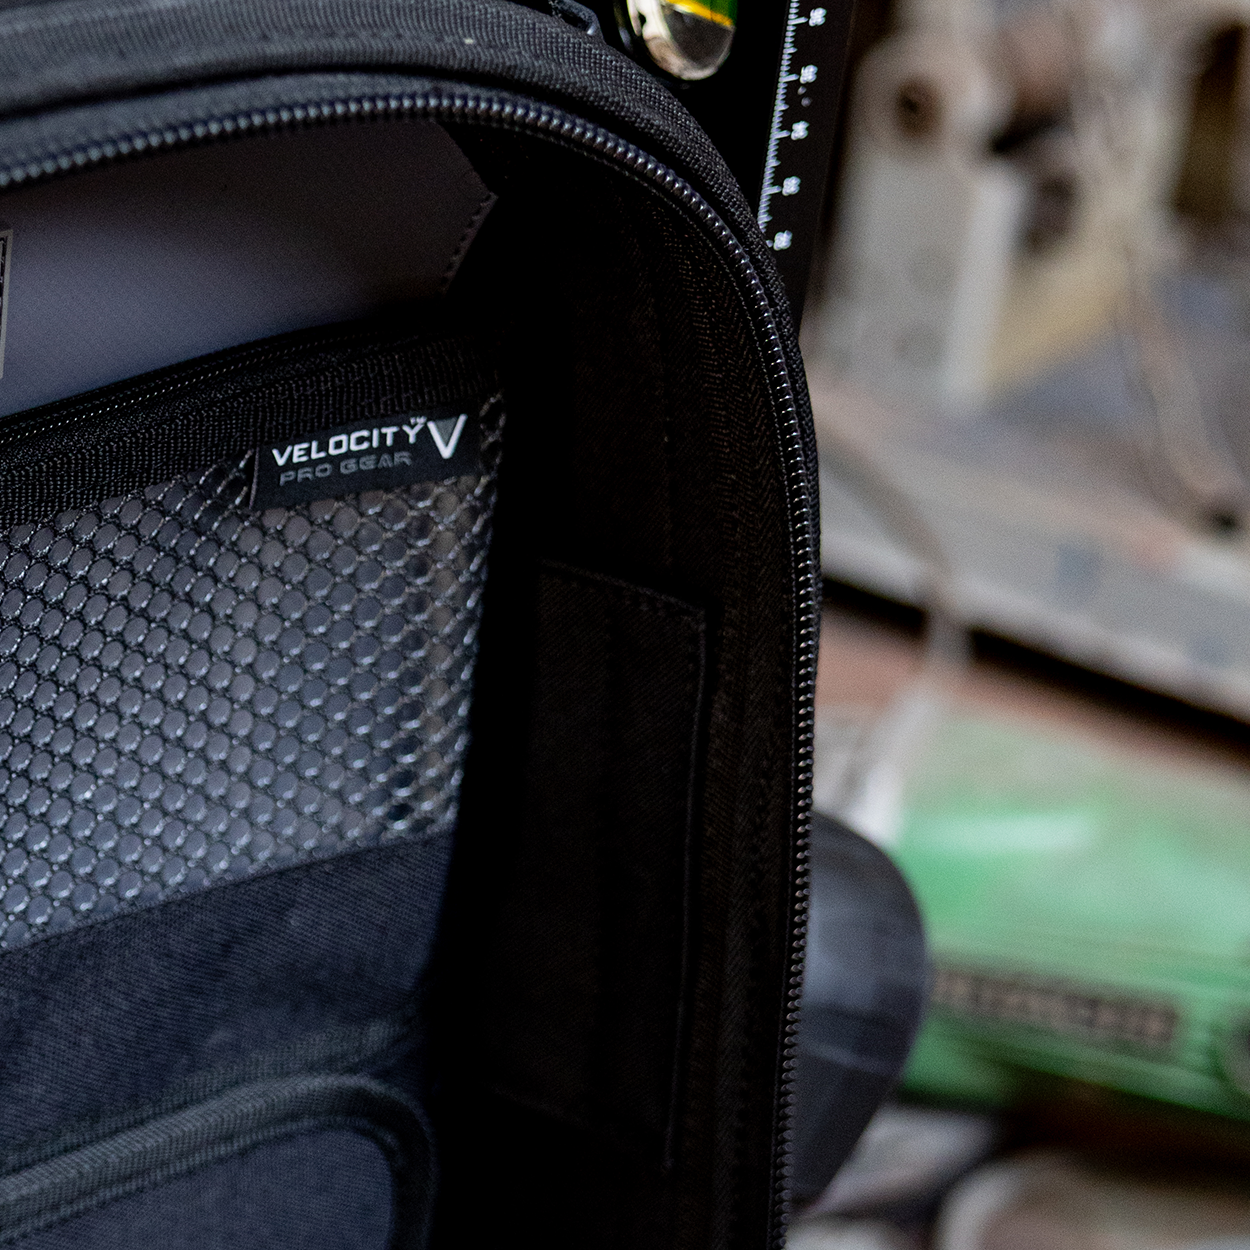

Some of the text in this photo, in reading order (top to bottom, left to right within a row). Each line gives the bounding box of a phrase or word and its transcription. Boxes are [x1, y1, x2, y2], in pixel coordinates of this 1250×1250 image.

[271, 423, 427, 467] VELOCITY
[278, 451, 413, 487] PRO GEAR
